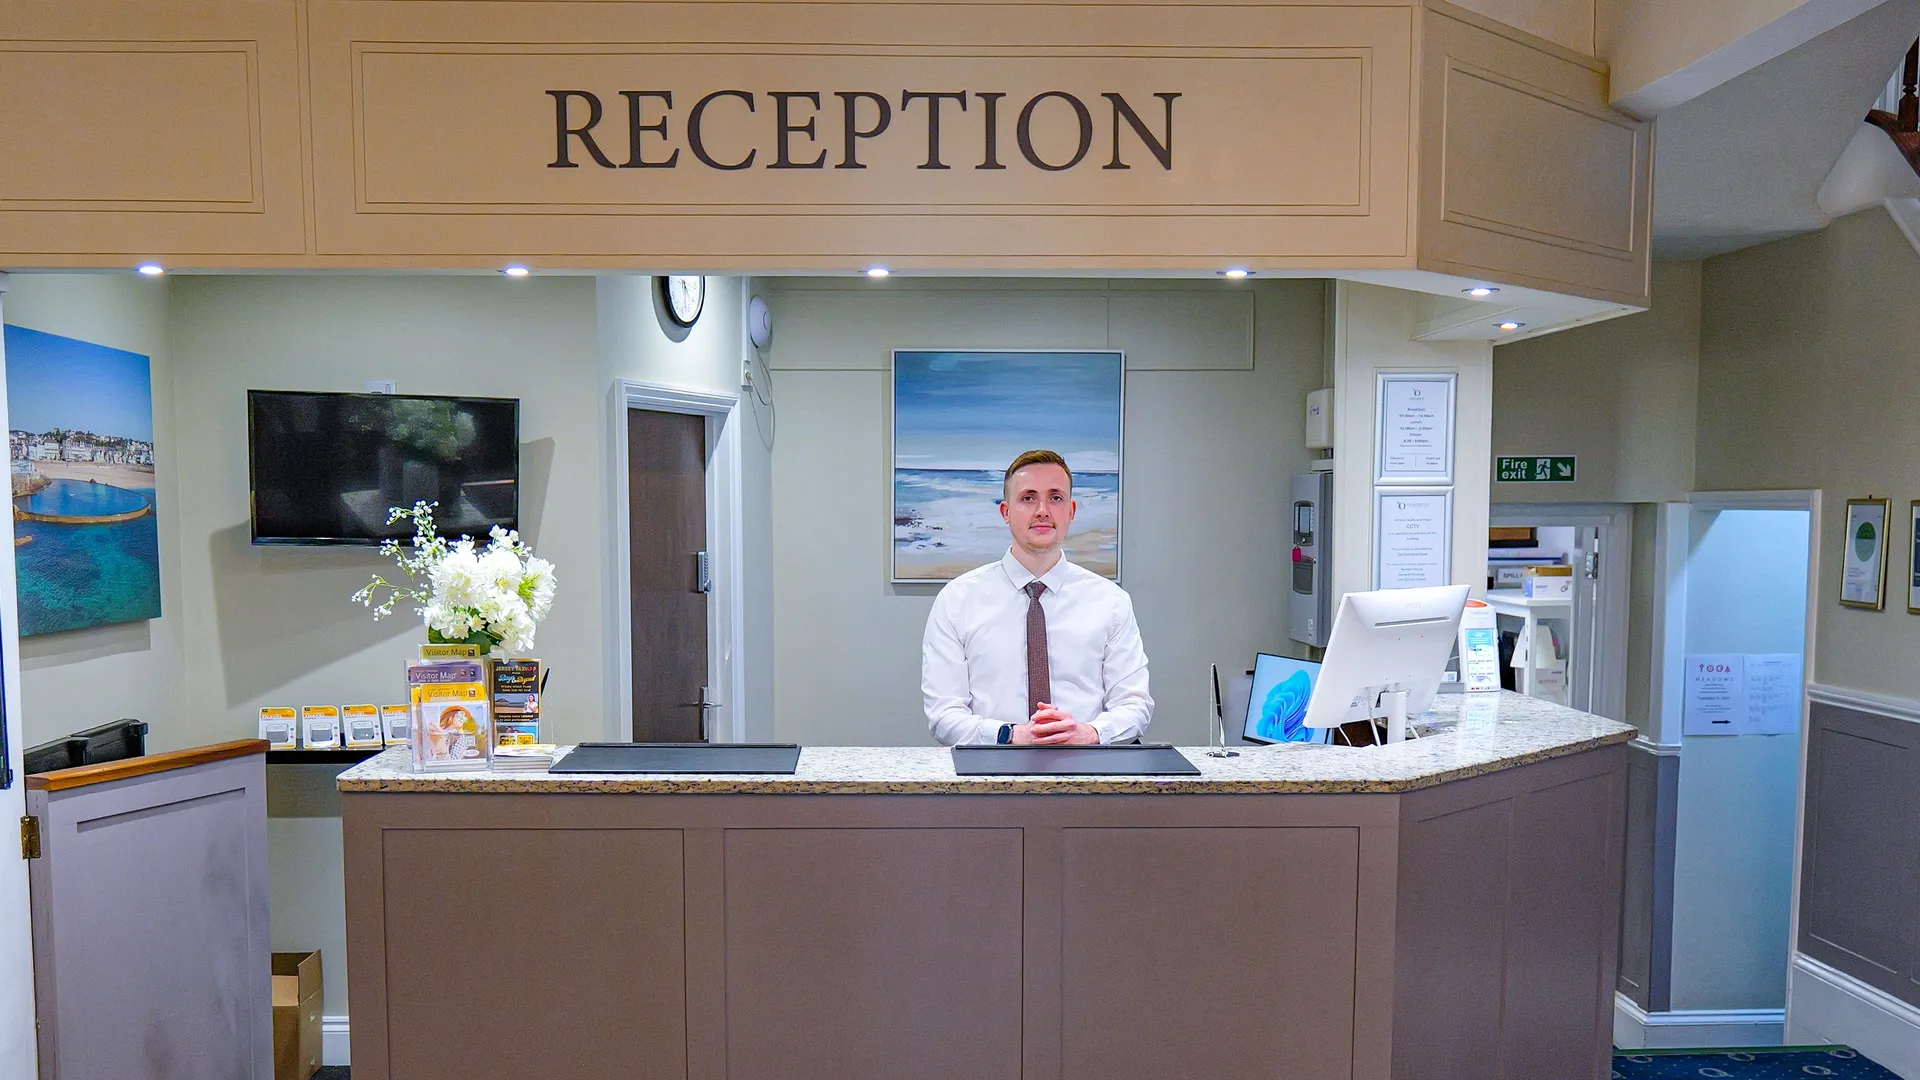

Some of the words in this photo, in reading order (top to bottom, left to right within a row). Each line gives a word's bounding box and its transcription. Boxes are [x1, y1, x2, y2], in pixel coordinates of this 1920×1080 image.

[545, 90, 1182, 171] RECEPTION
[1502, 459, 1528, 469] Fire
[1501, 468, 1526, 479] exit
[1699, 664, 1731, 673] YOGA
[415, 672, 438, 680] Visitor
[440, 671, 457, 680] Map
[428, 690, 451, 698] Visitor
[452, 690, 468, 698] Map
